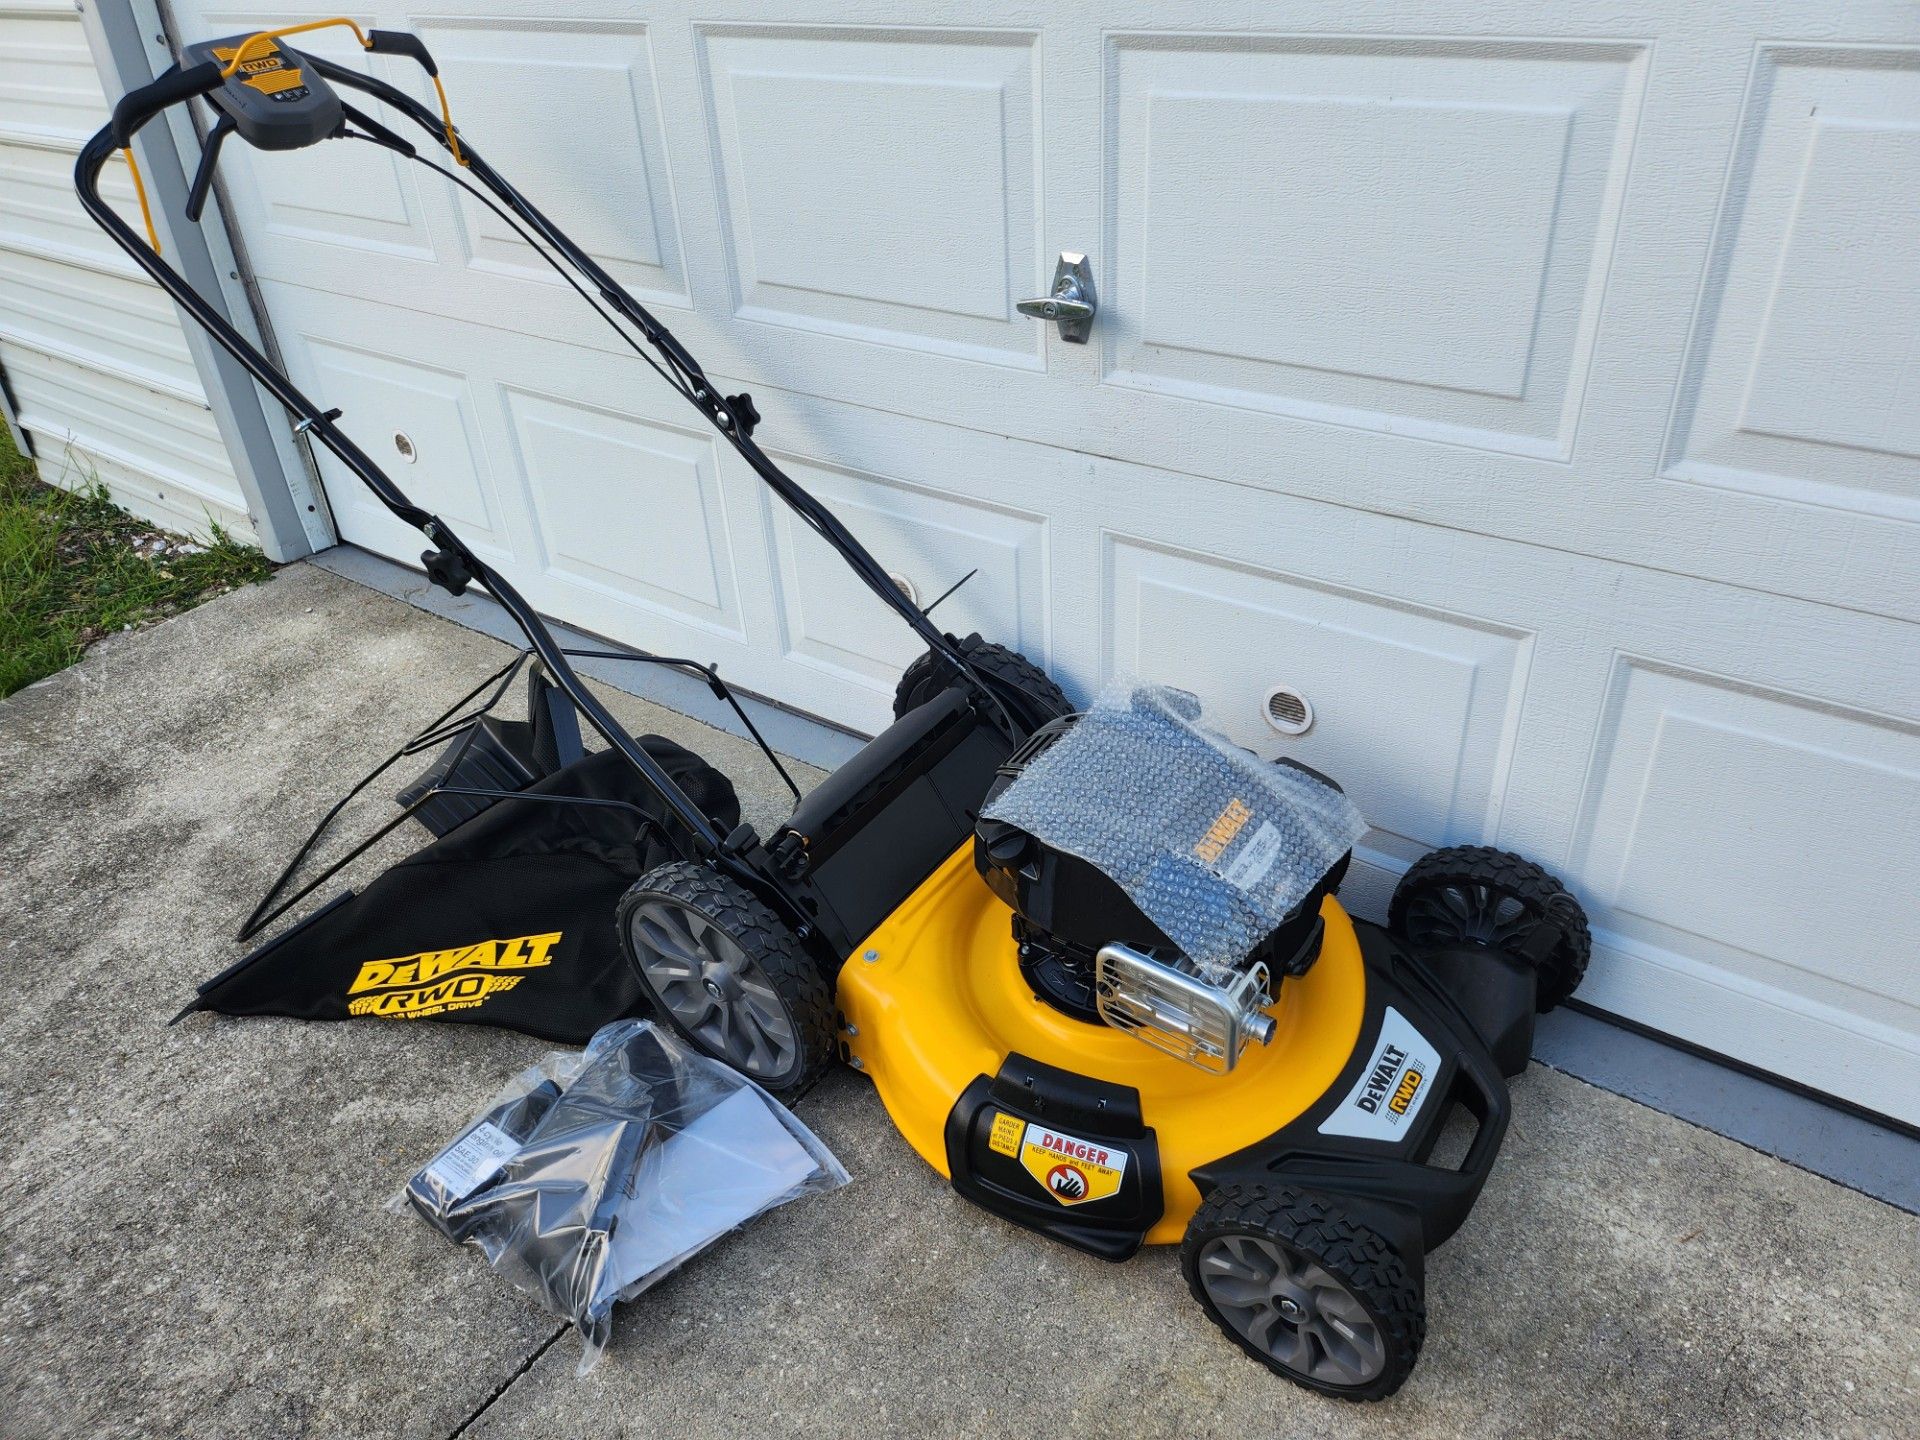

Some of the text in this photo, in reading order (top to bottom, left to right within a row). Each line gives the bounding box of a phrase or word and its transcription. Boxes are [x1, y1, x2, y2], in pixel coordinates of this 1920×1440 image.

[242, 58, 280, 72] RWD
[348, 933, 563, 994] DEWALT
[379, 977, 485, 1010] RWD
[407, 1005, 446, 1019] WHEEL
[448, 1000, 483, 1012] DRIVE
[1356, 1044, 1406, 1115] DEWALT
[1389, 1069, 1422, 1114] RWD
[998, 1126, 1015, 1137] MAINS
[1032, 1146, 1113, 1177] KEEP HANDS and FEET AWAY
[1042, 1133, 1109, 1166] DANGER
